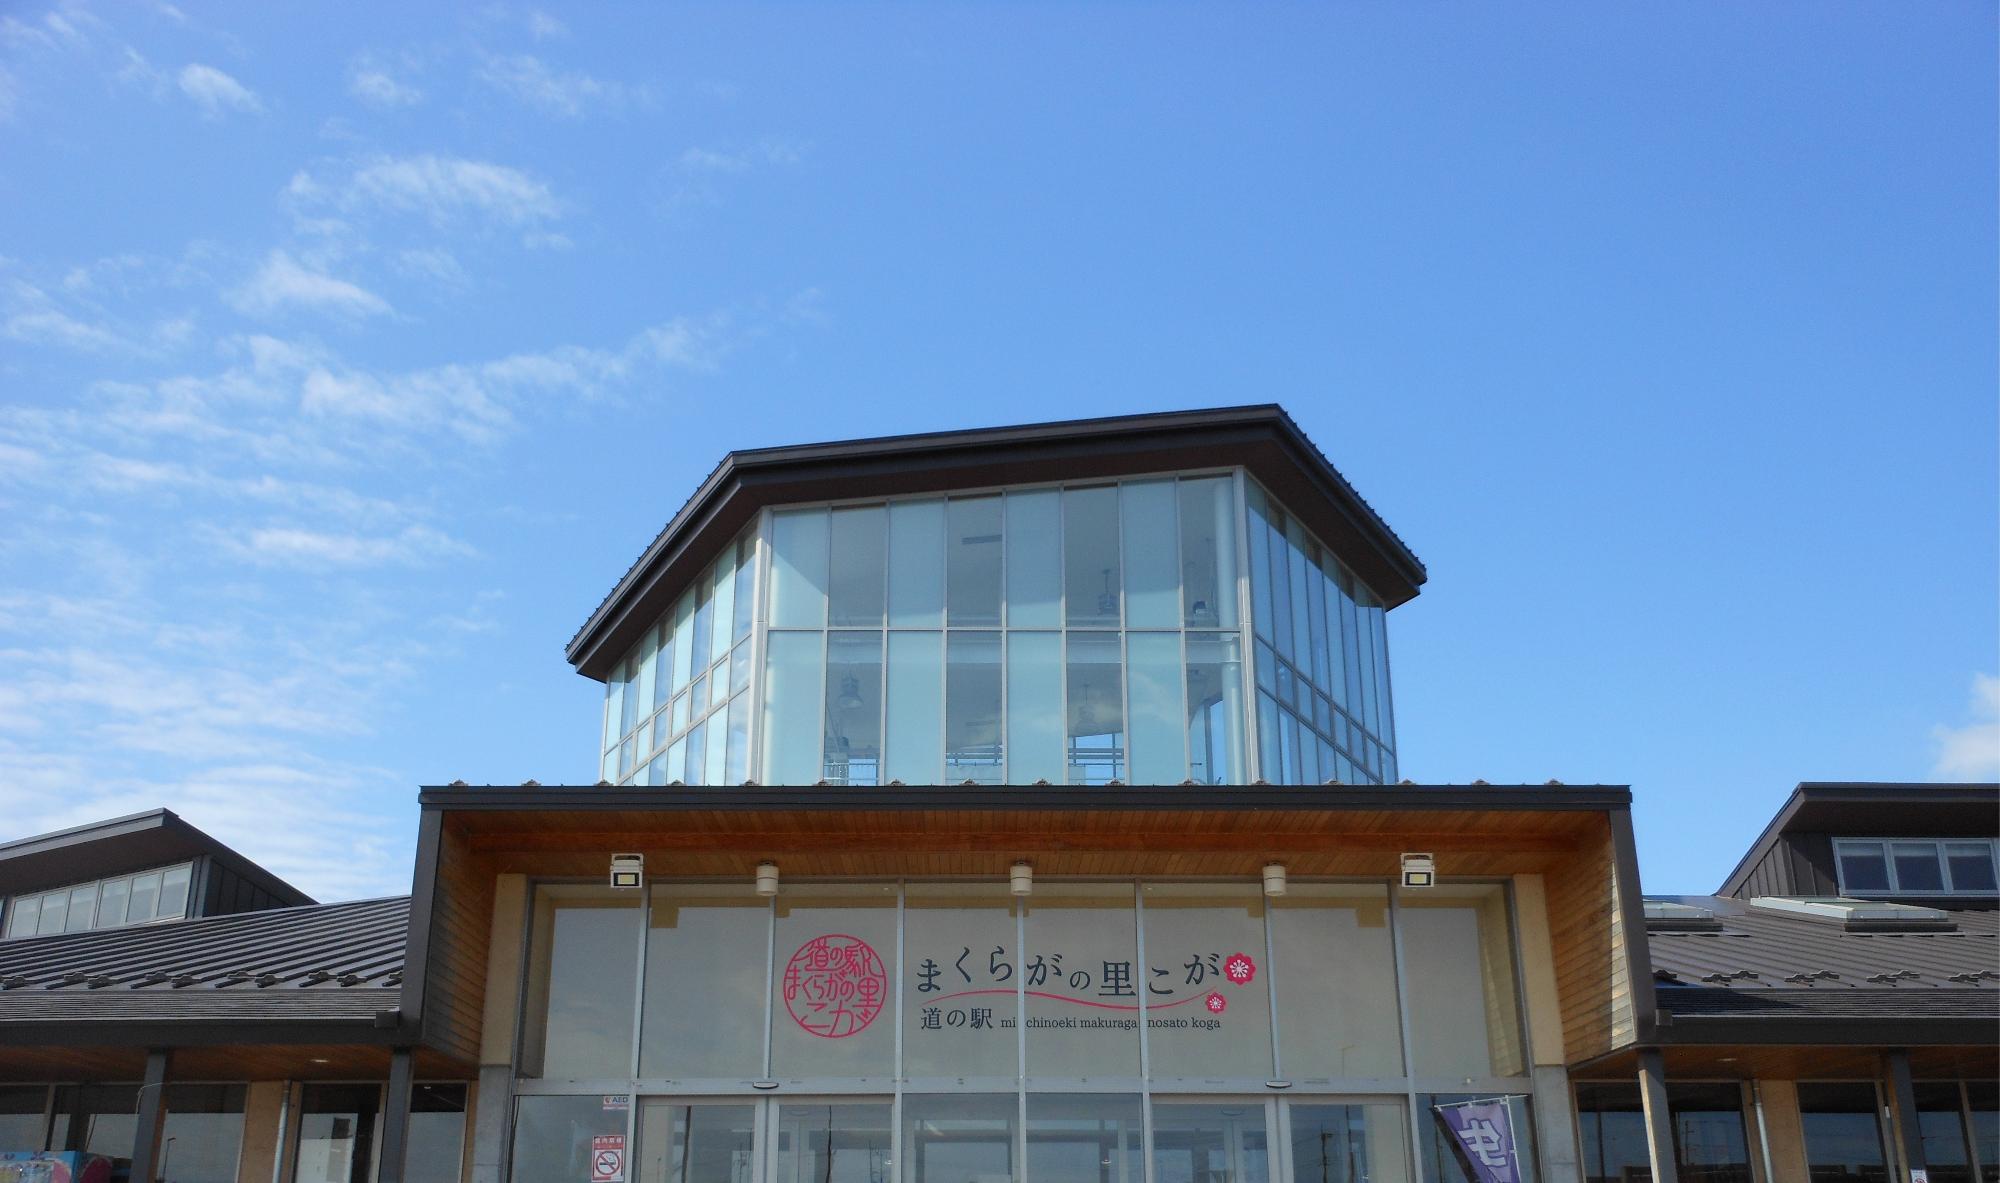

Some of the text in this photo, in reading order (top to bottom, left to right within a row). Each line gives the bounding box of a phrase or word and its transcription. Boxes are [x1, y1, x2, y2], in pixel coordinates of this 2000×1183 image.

[804, 937, 884, 977] 道の駅
[920, 1007, 994, 1030] 道の駅
[1191, 1016, 1221, 1030] koga
